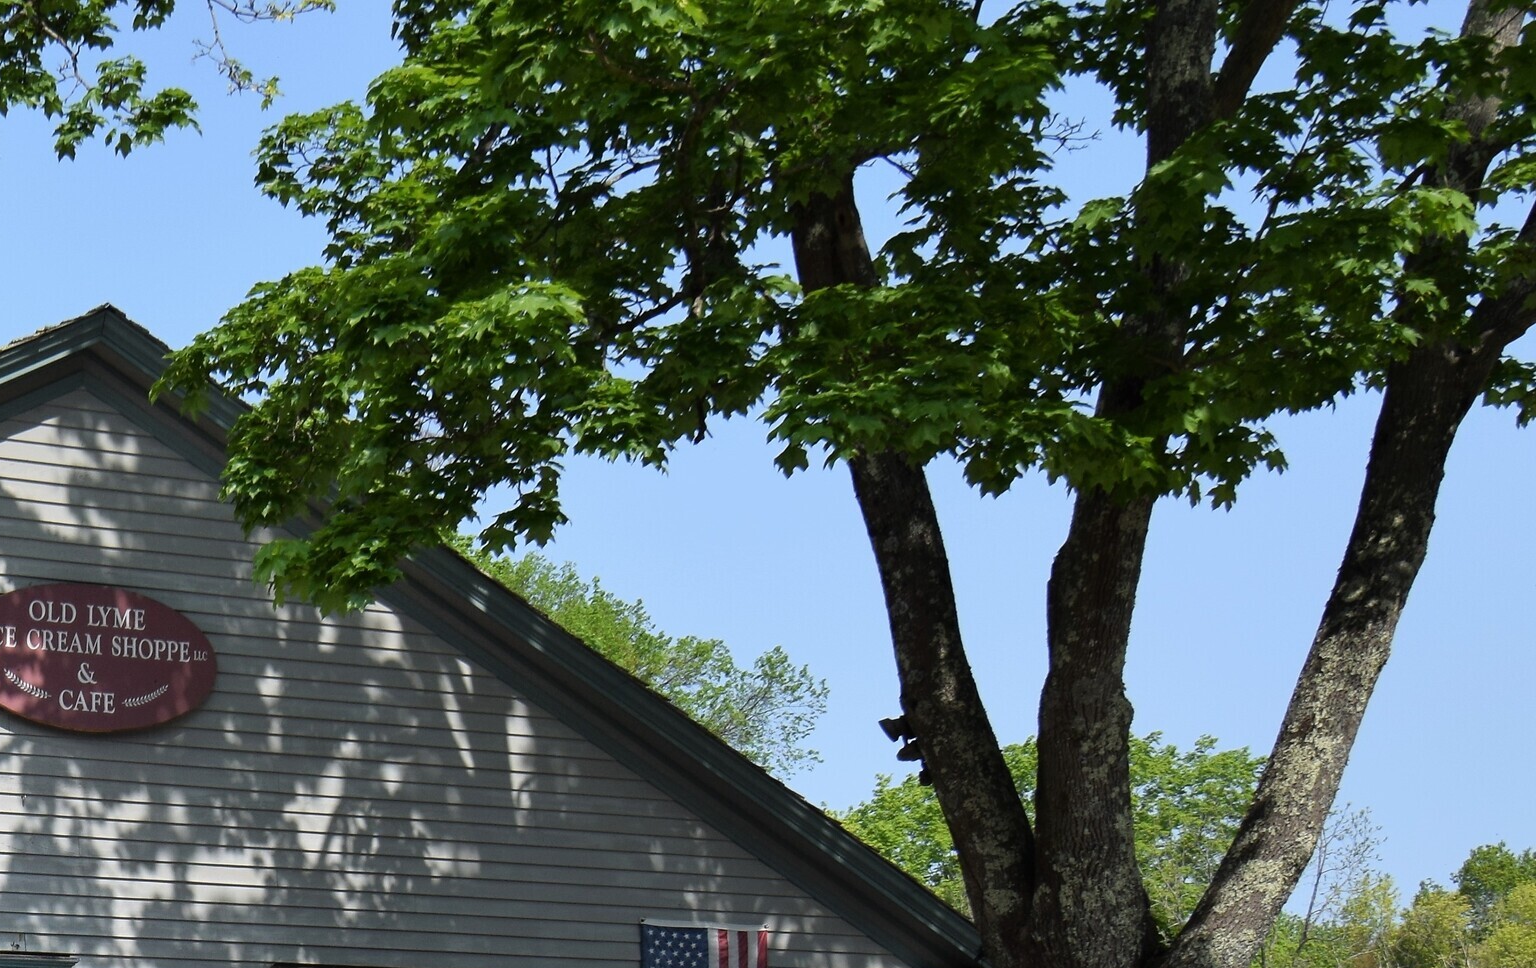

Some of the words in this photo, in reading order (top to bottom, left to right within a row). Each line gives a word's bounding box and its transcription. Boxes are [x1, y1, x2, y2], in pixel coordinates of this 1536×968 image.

[28, 600, 77, 624] OLD
[86, 604, 146, 631] LYME
[26, 628, 103, 655] CREAM
[111, 635, 191, 663] SHOPPE
[193, 650, 208, 662] LLC
[77, 662, 97, 685] &
[58, 689, 116, 714] CAFE
